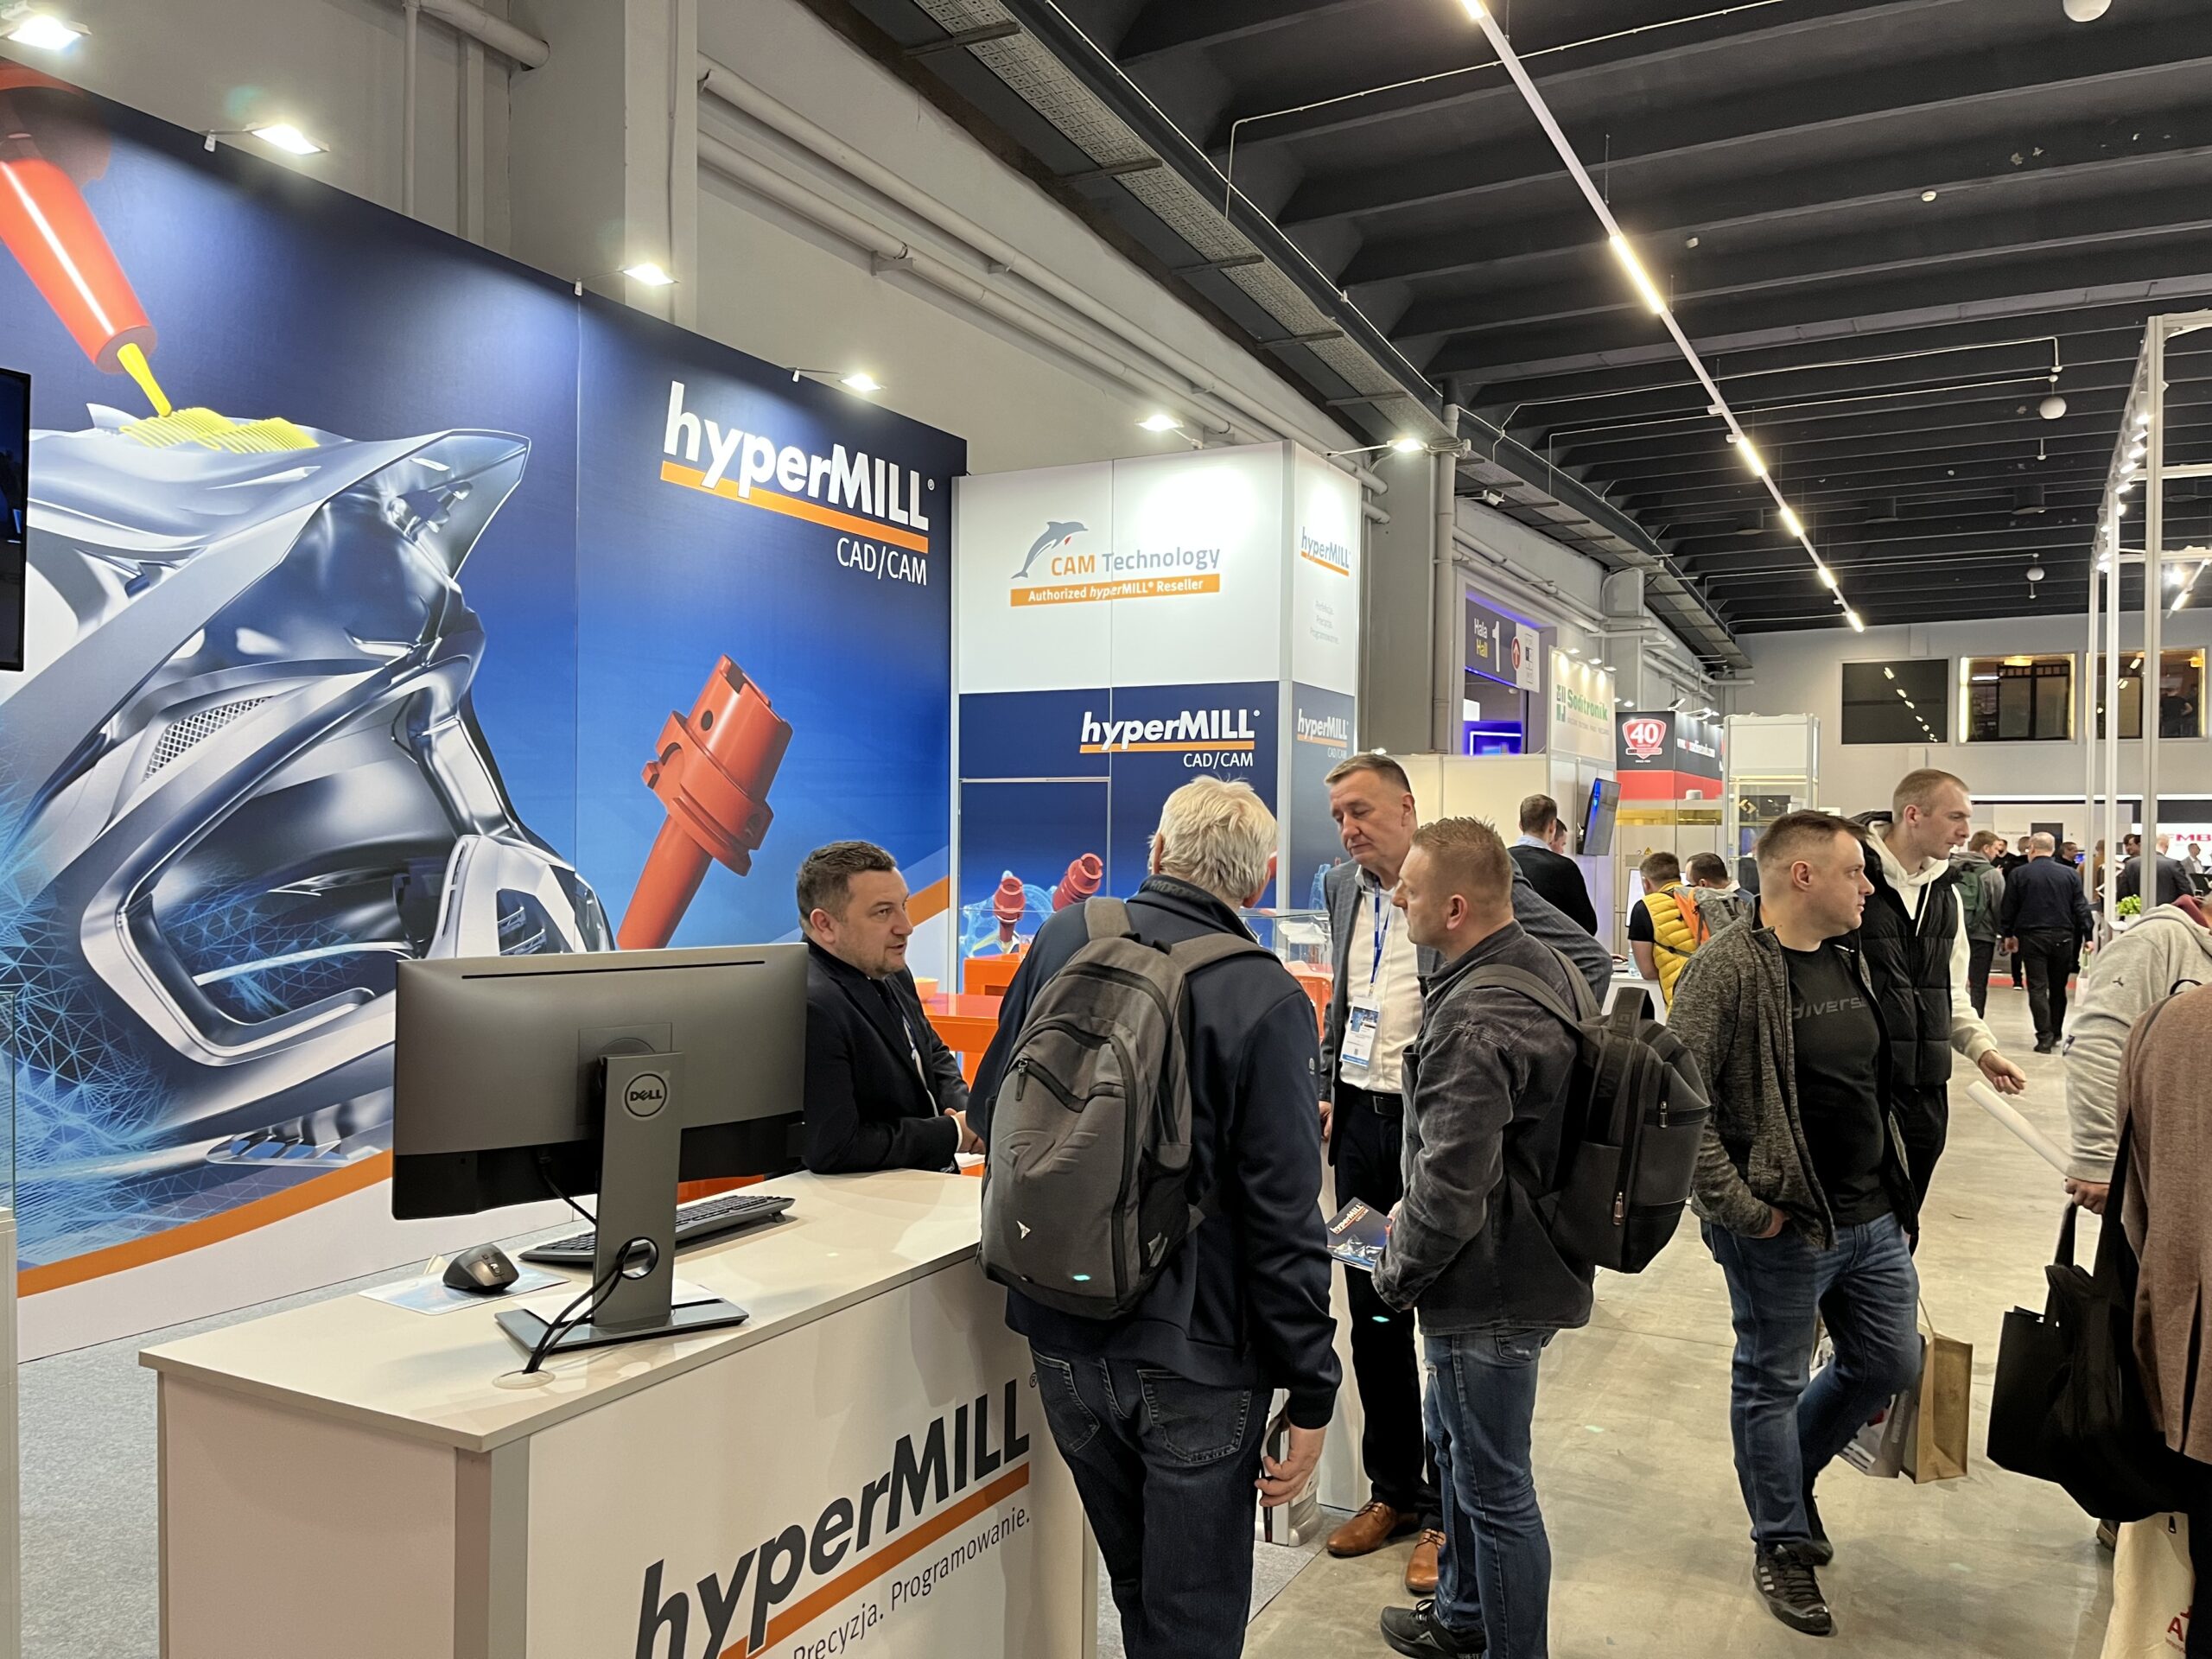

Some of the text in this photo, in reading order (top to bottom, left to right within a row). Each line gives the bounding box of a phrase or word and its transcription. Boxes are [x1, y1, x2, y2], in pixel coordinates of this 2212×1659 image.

[836, 537, 927, 586] CAD/CAM
[1051, 547, 1221, 576] CAM Technology
[1028, 584, 1086, 602] Authorized
[1156, 579, 1204, 593] Reseller
[1474, 618, 1488, 639] Hala
[1476, 638, 1488, 658] Hall
[1492, 620, 1500, 672] 1
[1630, 723, 1659, 744] 40
[1183, 752, 1253, 770] CAD/CAM
[630, 1090, 663, 1102] DELL
[892, 1506, 1032, 1611] Programowanie.
